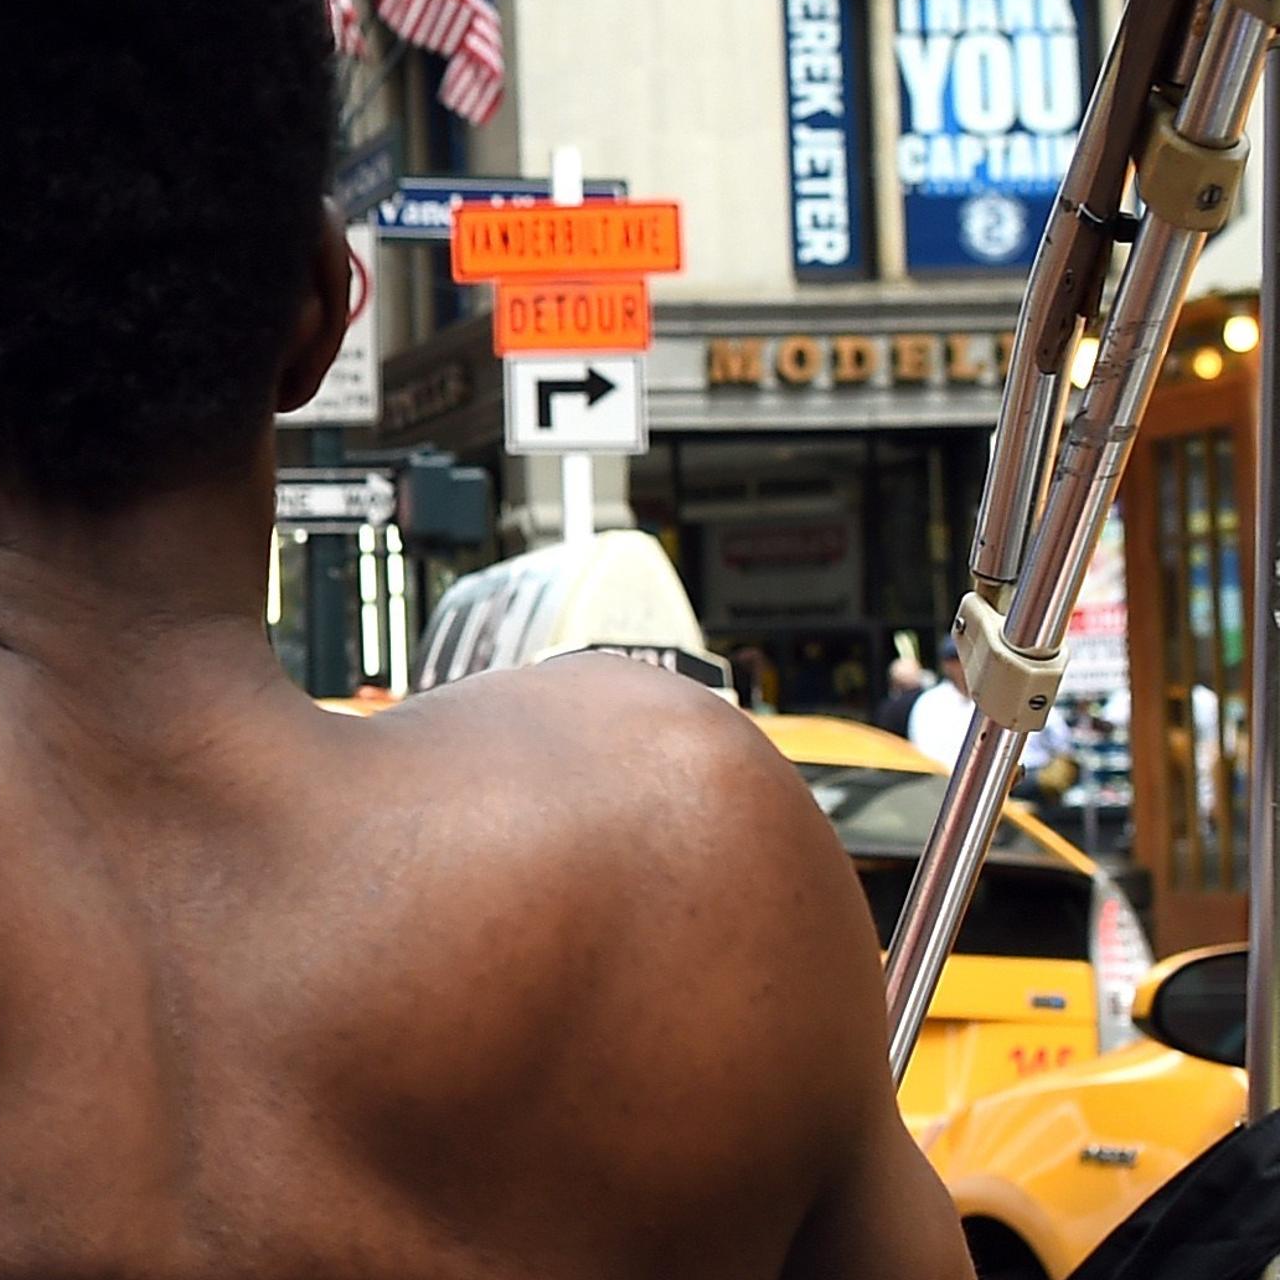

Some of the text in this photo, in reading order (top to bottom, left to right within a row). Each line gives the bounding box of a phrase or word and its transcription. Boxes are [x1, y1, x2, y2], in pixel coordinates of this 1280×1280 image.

[896, 30, 1081, 135] YOU
[792, 122, 849, 265] JETER
[469, 215, 609, 257] VANDERBILT
[508, 294, 638, 335] DETOUR
